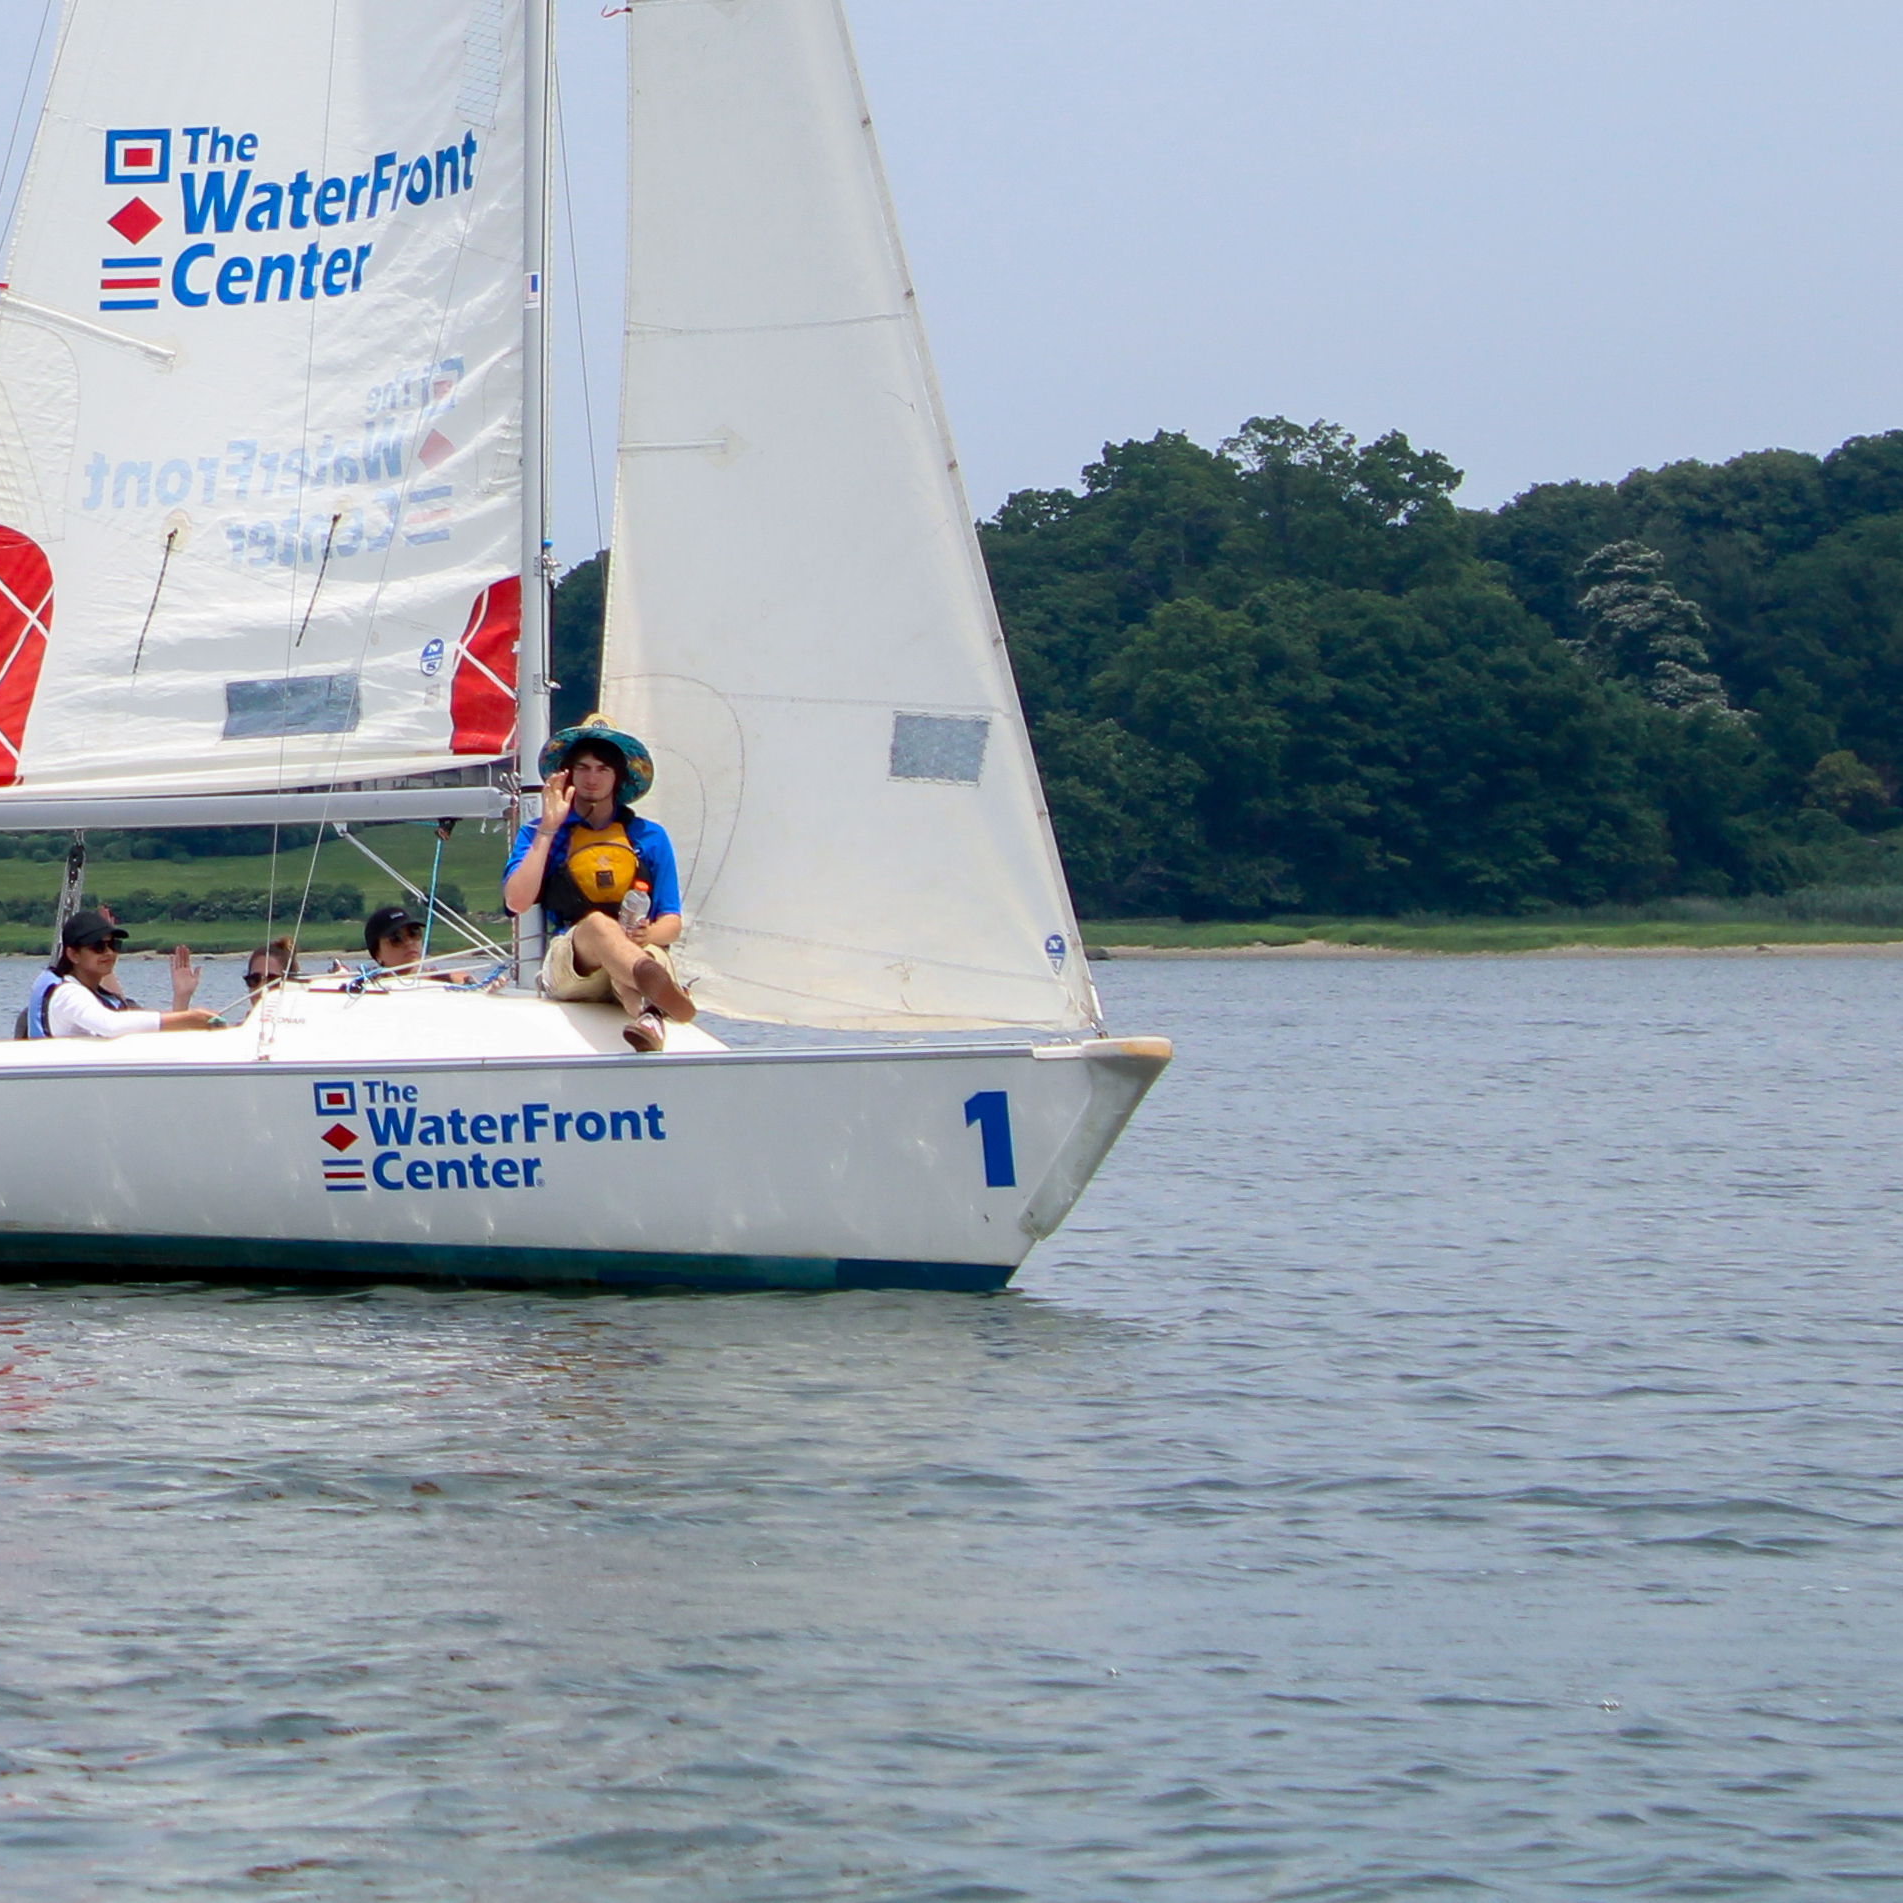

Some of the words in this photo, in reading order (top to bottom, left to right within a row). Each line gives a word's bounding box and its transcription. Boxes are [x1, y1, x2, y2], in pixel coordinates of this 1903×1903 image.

[182, 126, 259, 165] The
[180, 128, 478, 235] WaterFront
[171, 240, 373, 309] Center
[362, 1080, 419, 1104] The
[365, 1103, 667, 1147] WaterFront
[964, 1091, 1017, 1188] 1
